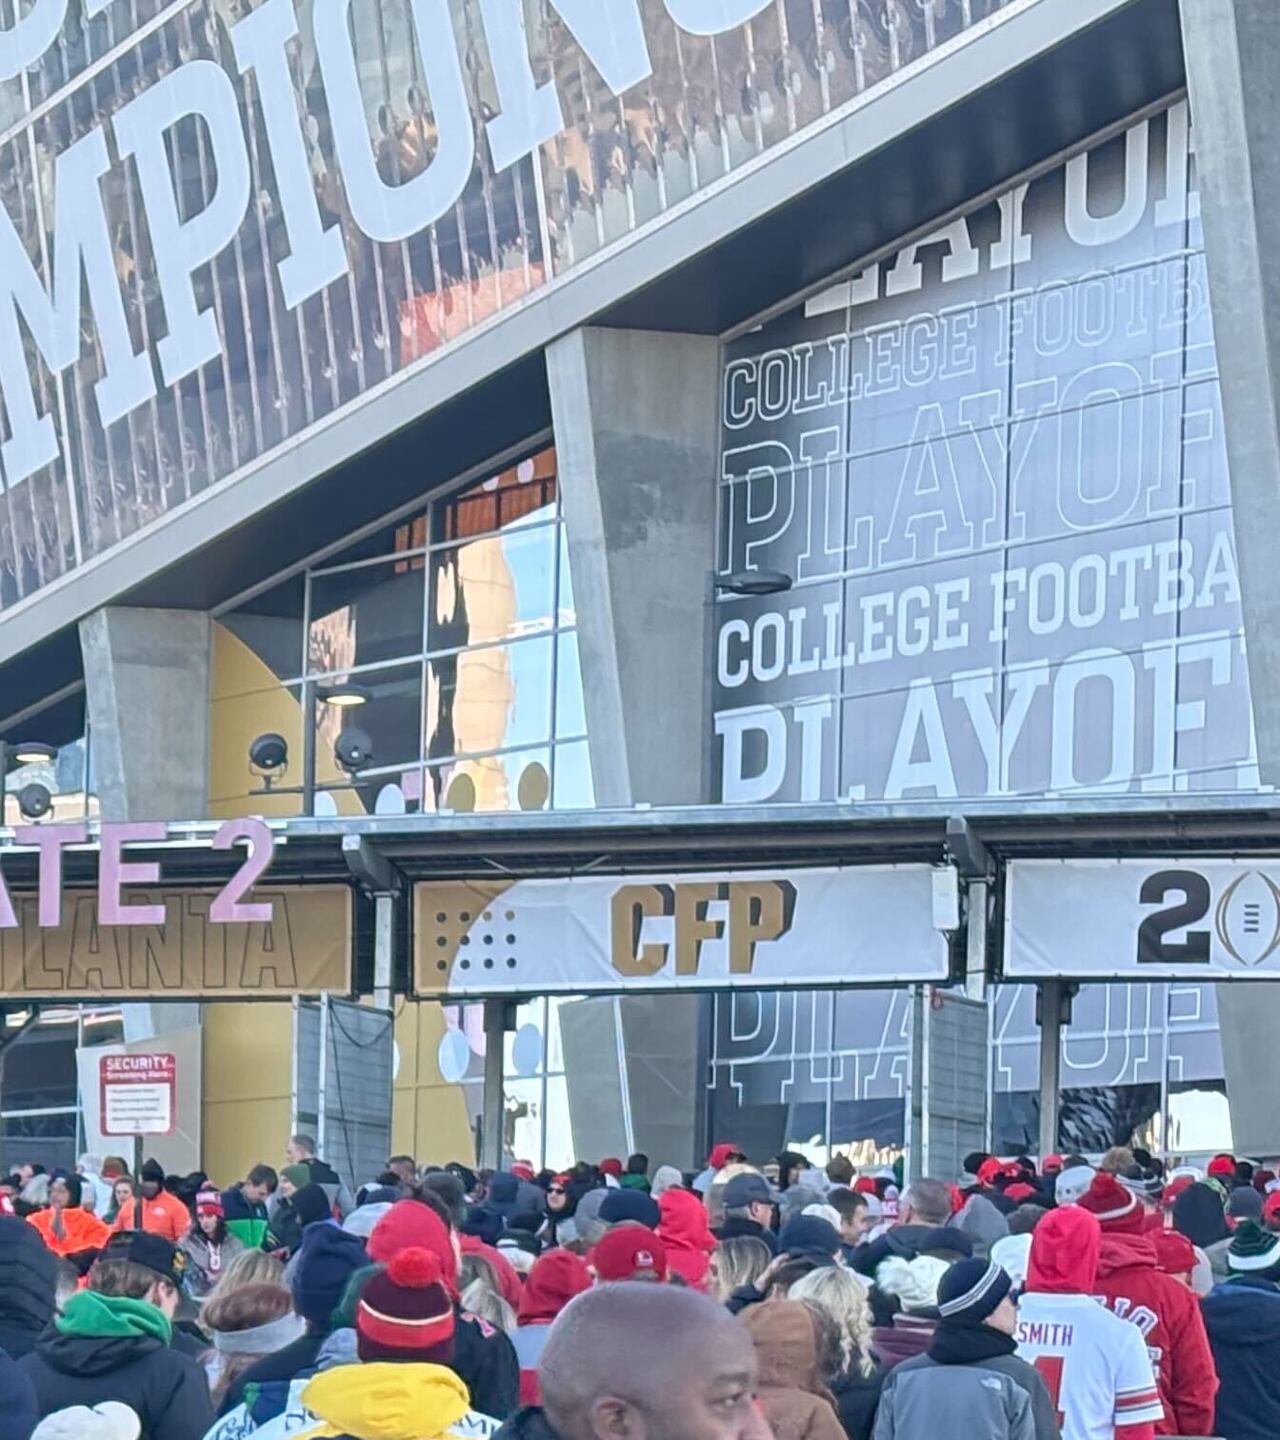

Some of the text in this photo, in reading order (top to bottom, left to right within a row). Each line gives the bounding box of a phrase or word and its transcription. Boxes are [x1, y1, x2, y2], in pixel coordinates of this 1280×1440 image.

[723, 300, 978, 430] COLLEGE
[717, 576, 970, 688] COLLEGE
[209, 816, 275, 924] 2
[610, 878, 798, 978] CFP
[106, 1056, 169, 1070] SECURITY
[1017, 1321, 1074, 1347] SMITH
